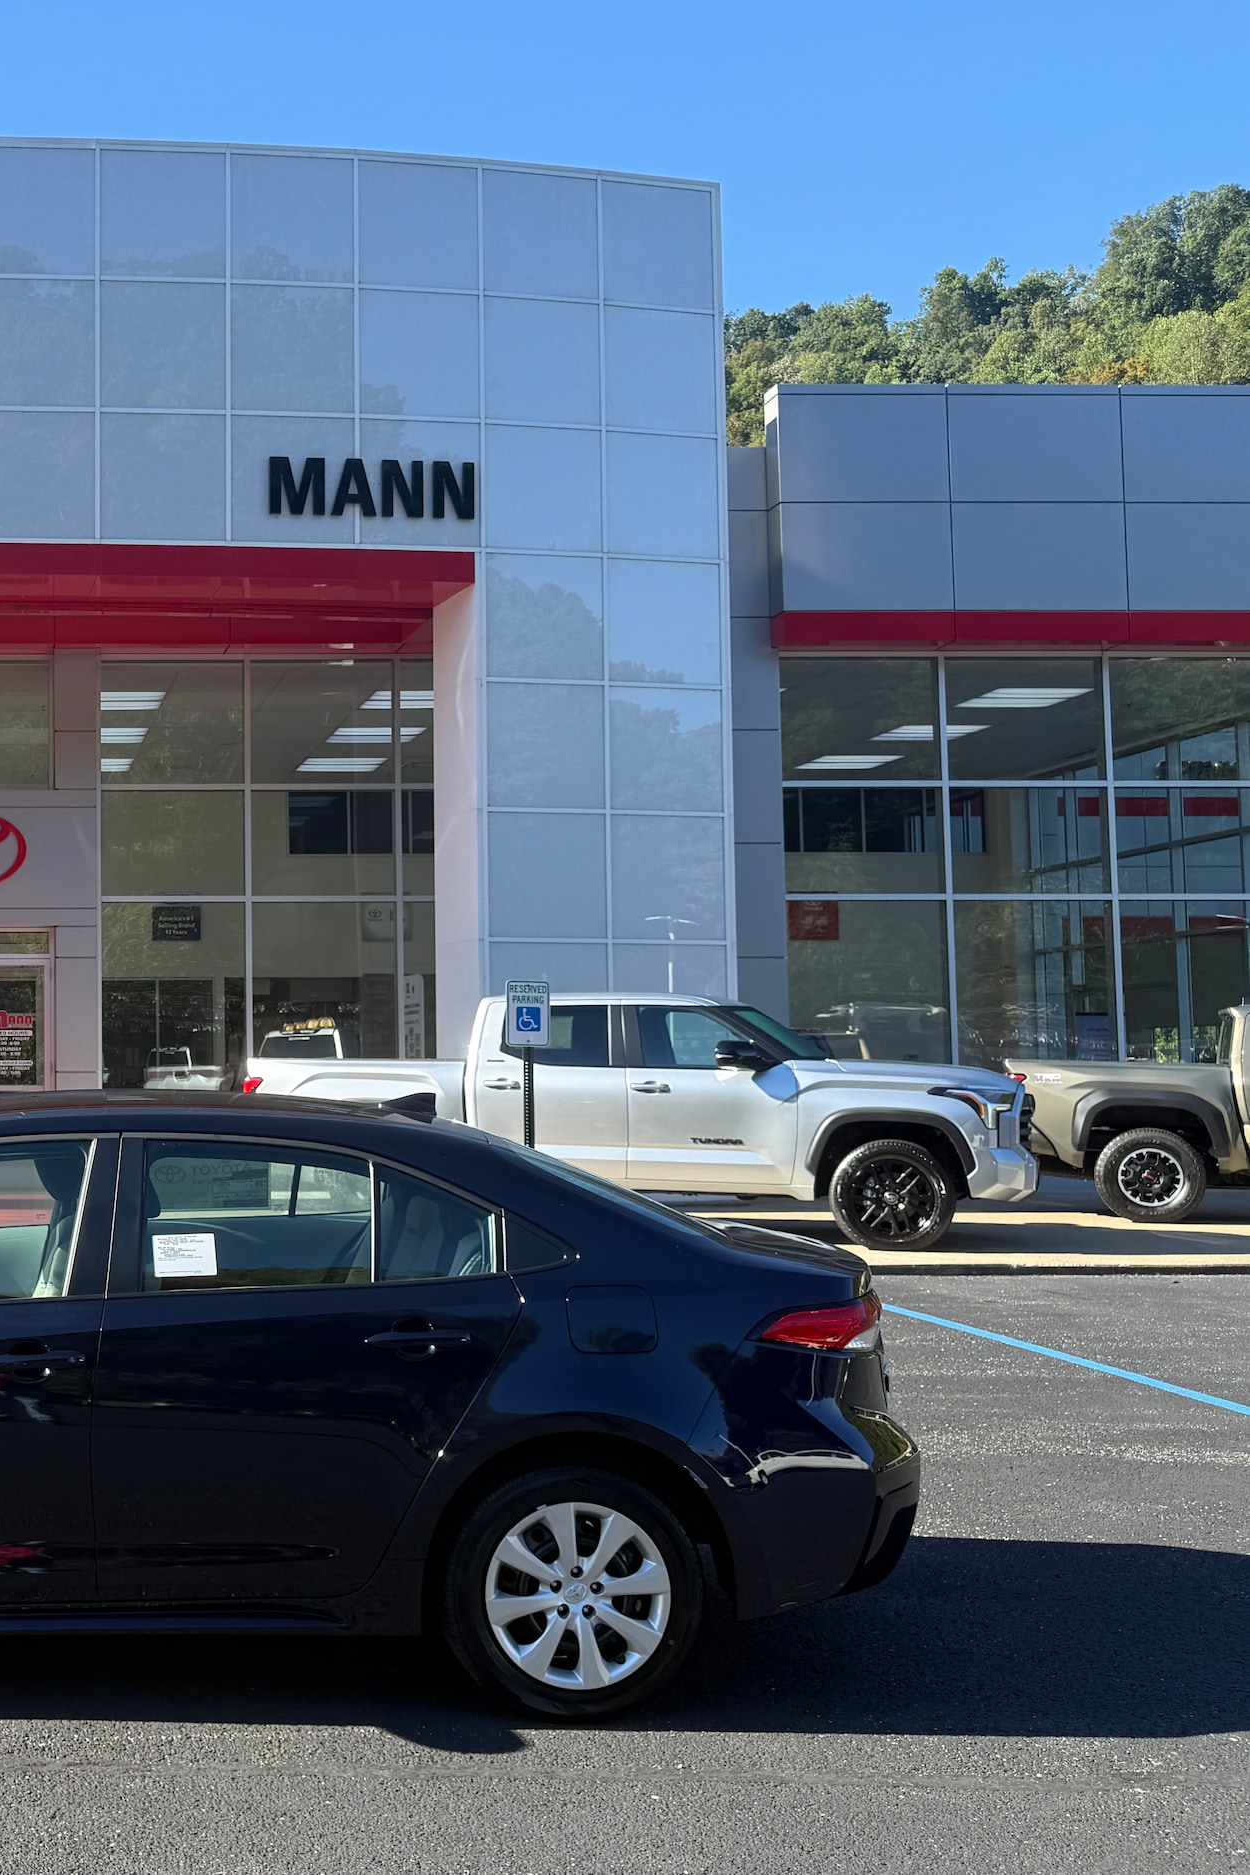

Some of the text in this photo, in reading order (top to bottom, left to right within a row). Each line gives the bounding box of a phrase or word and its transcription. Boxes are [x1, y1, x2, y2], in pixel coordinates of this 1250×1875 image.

[269, 456, 475, 520] MANN
[510, 985, 546, 993] RESERVED
[512, 995, 544, 1004] PARKING
[690, 1137, 745, 1146] TUNDRA
[191, 1163, 252, 1177] TOYOTA
